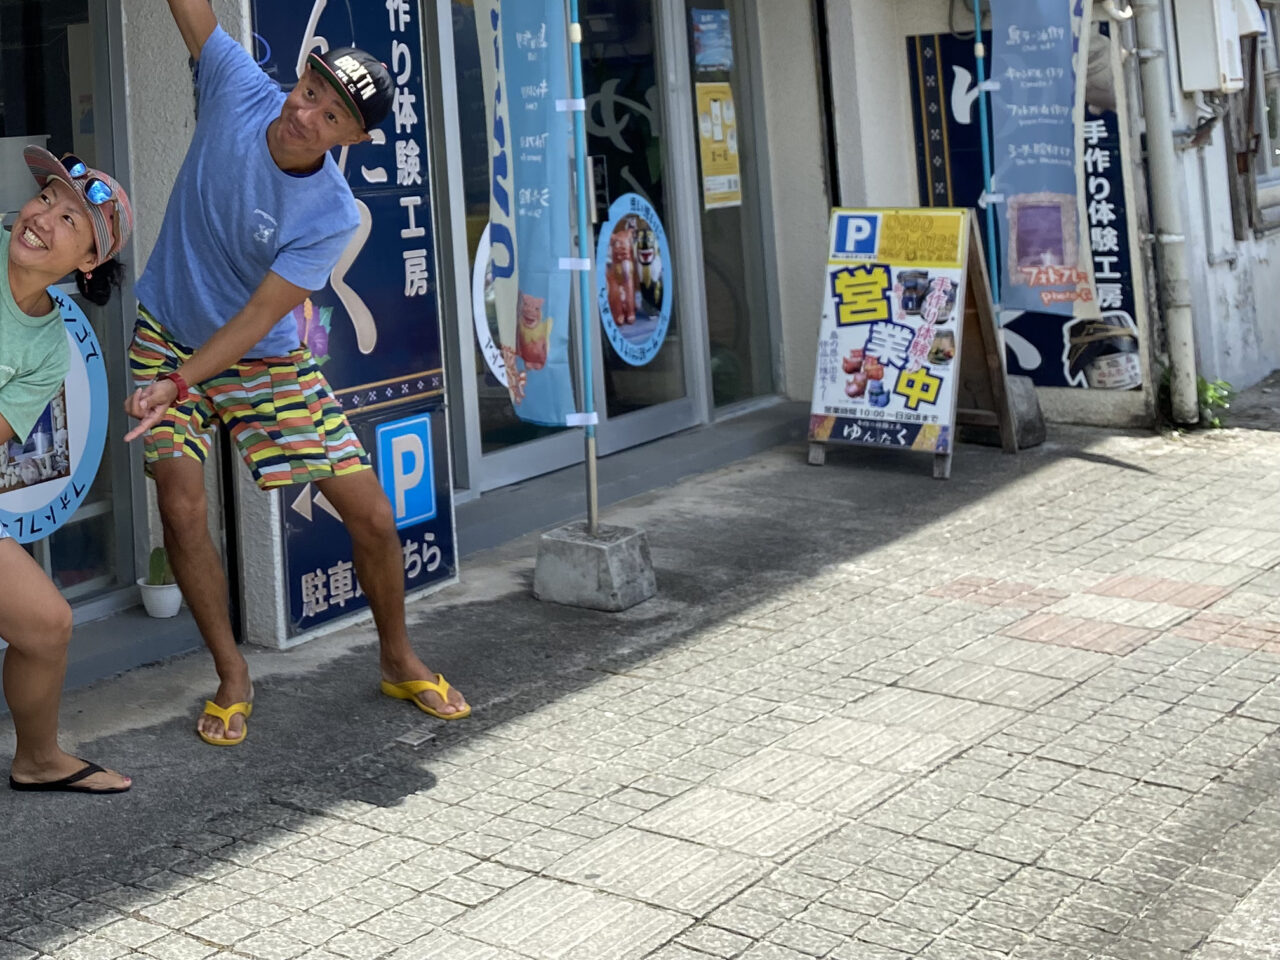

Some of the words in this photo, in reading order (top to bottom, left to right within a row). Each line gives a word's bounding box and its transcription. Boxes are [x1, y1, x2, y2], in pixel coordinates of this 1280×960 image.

[845, 217, 871, 252] P
[1082, 120, 1123, 308] 手作り体験工房
[830, 264, 945, 412] 営業中
[391, 433, 425, 519] P
[842, 423, 908, 446] ゆんたく
